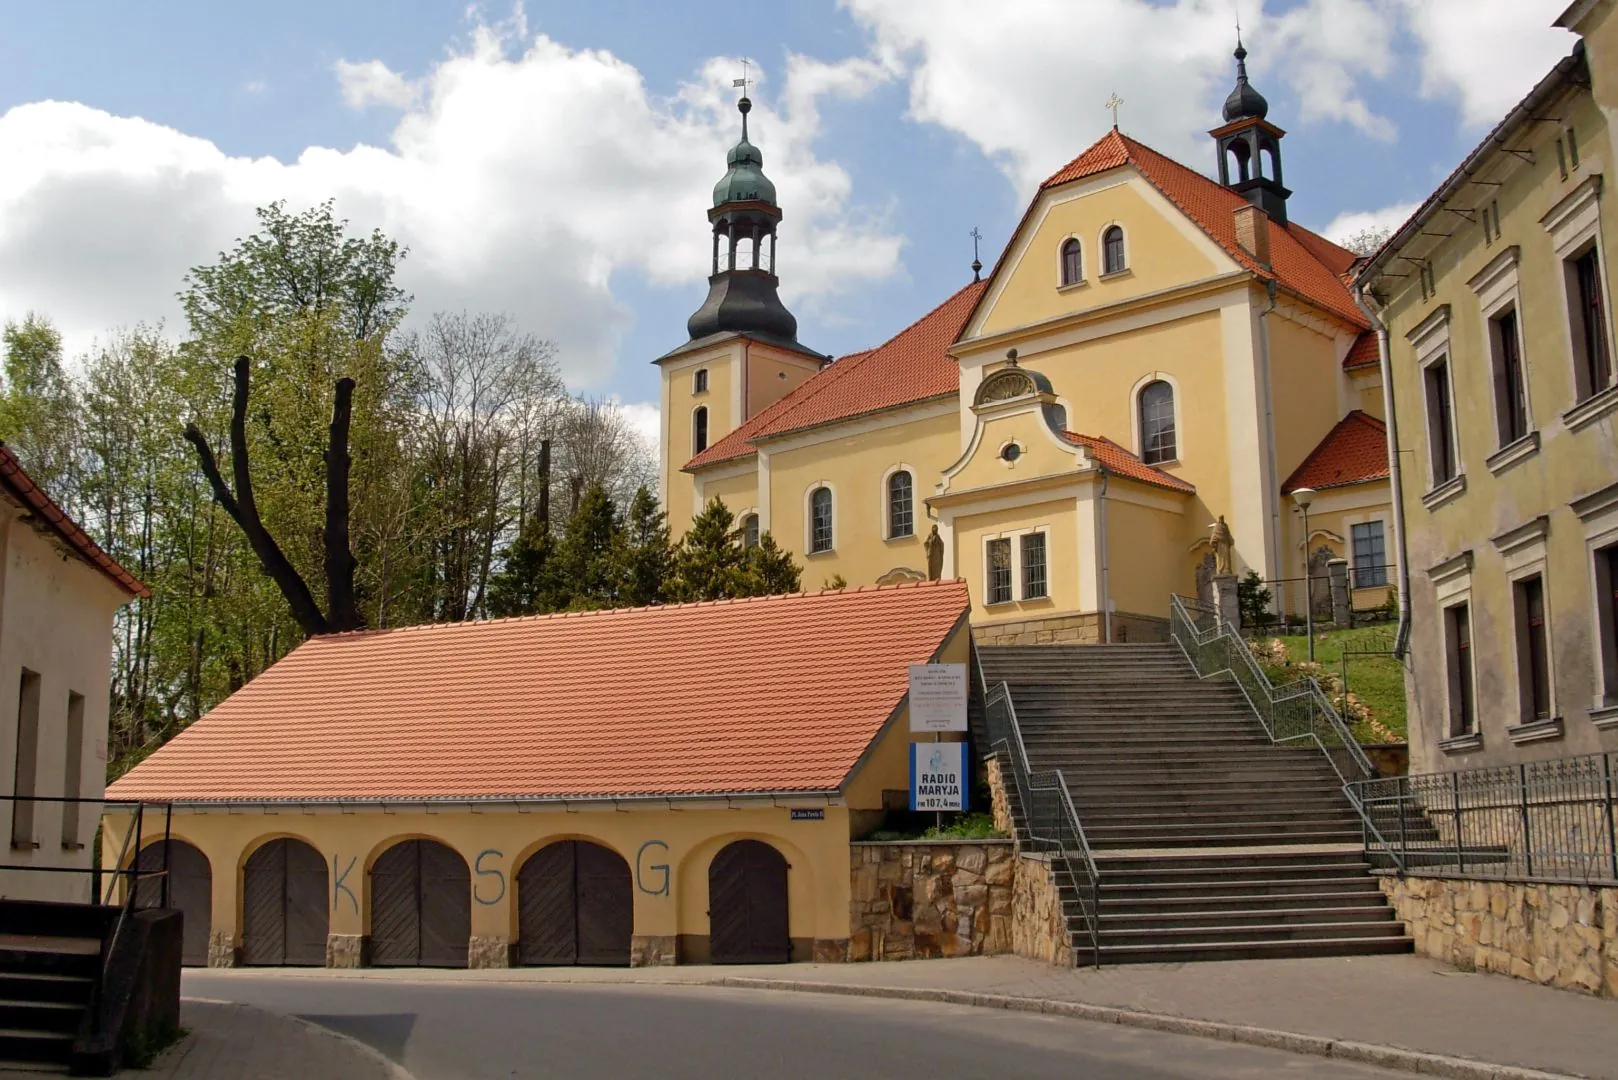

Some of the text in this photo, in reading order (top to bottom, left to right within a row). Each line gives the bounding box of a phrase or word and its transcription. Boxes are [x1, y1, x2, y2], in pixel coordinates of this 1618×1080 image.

[922, 774, 956, 784] RADIO
[919, 785, 959, 795] MARYJA
[333, 840, 670, 915] K S G
